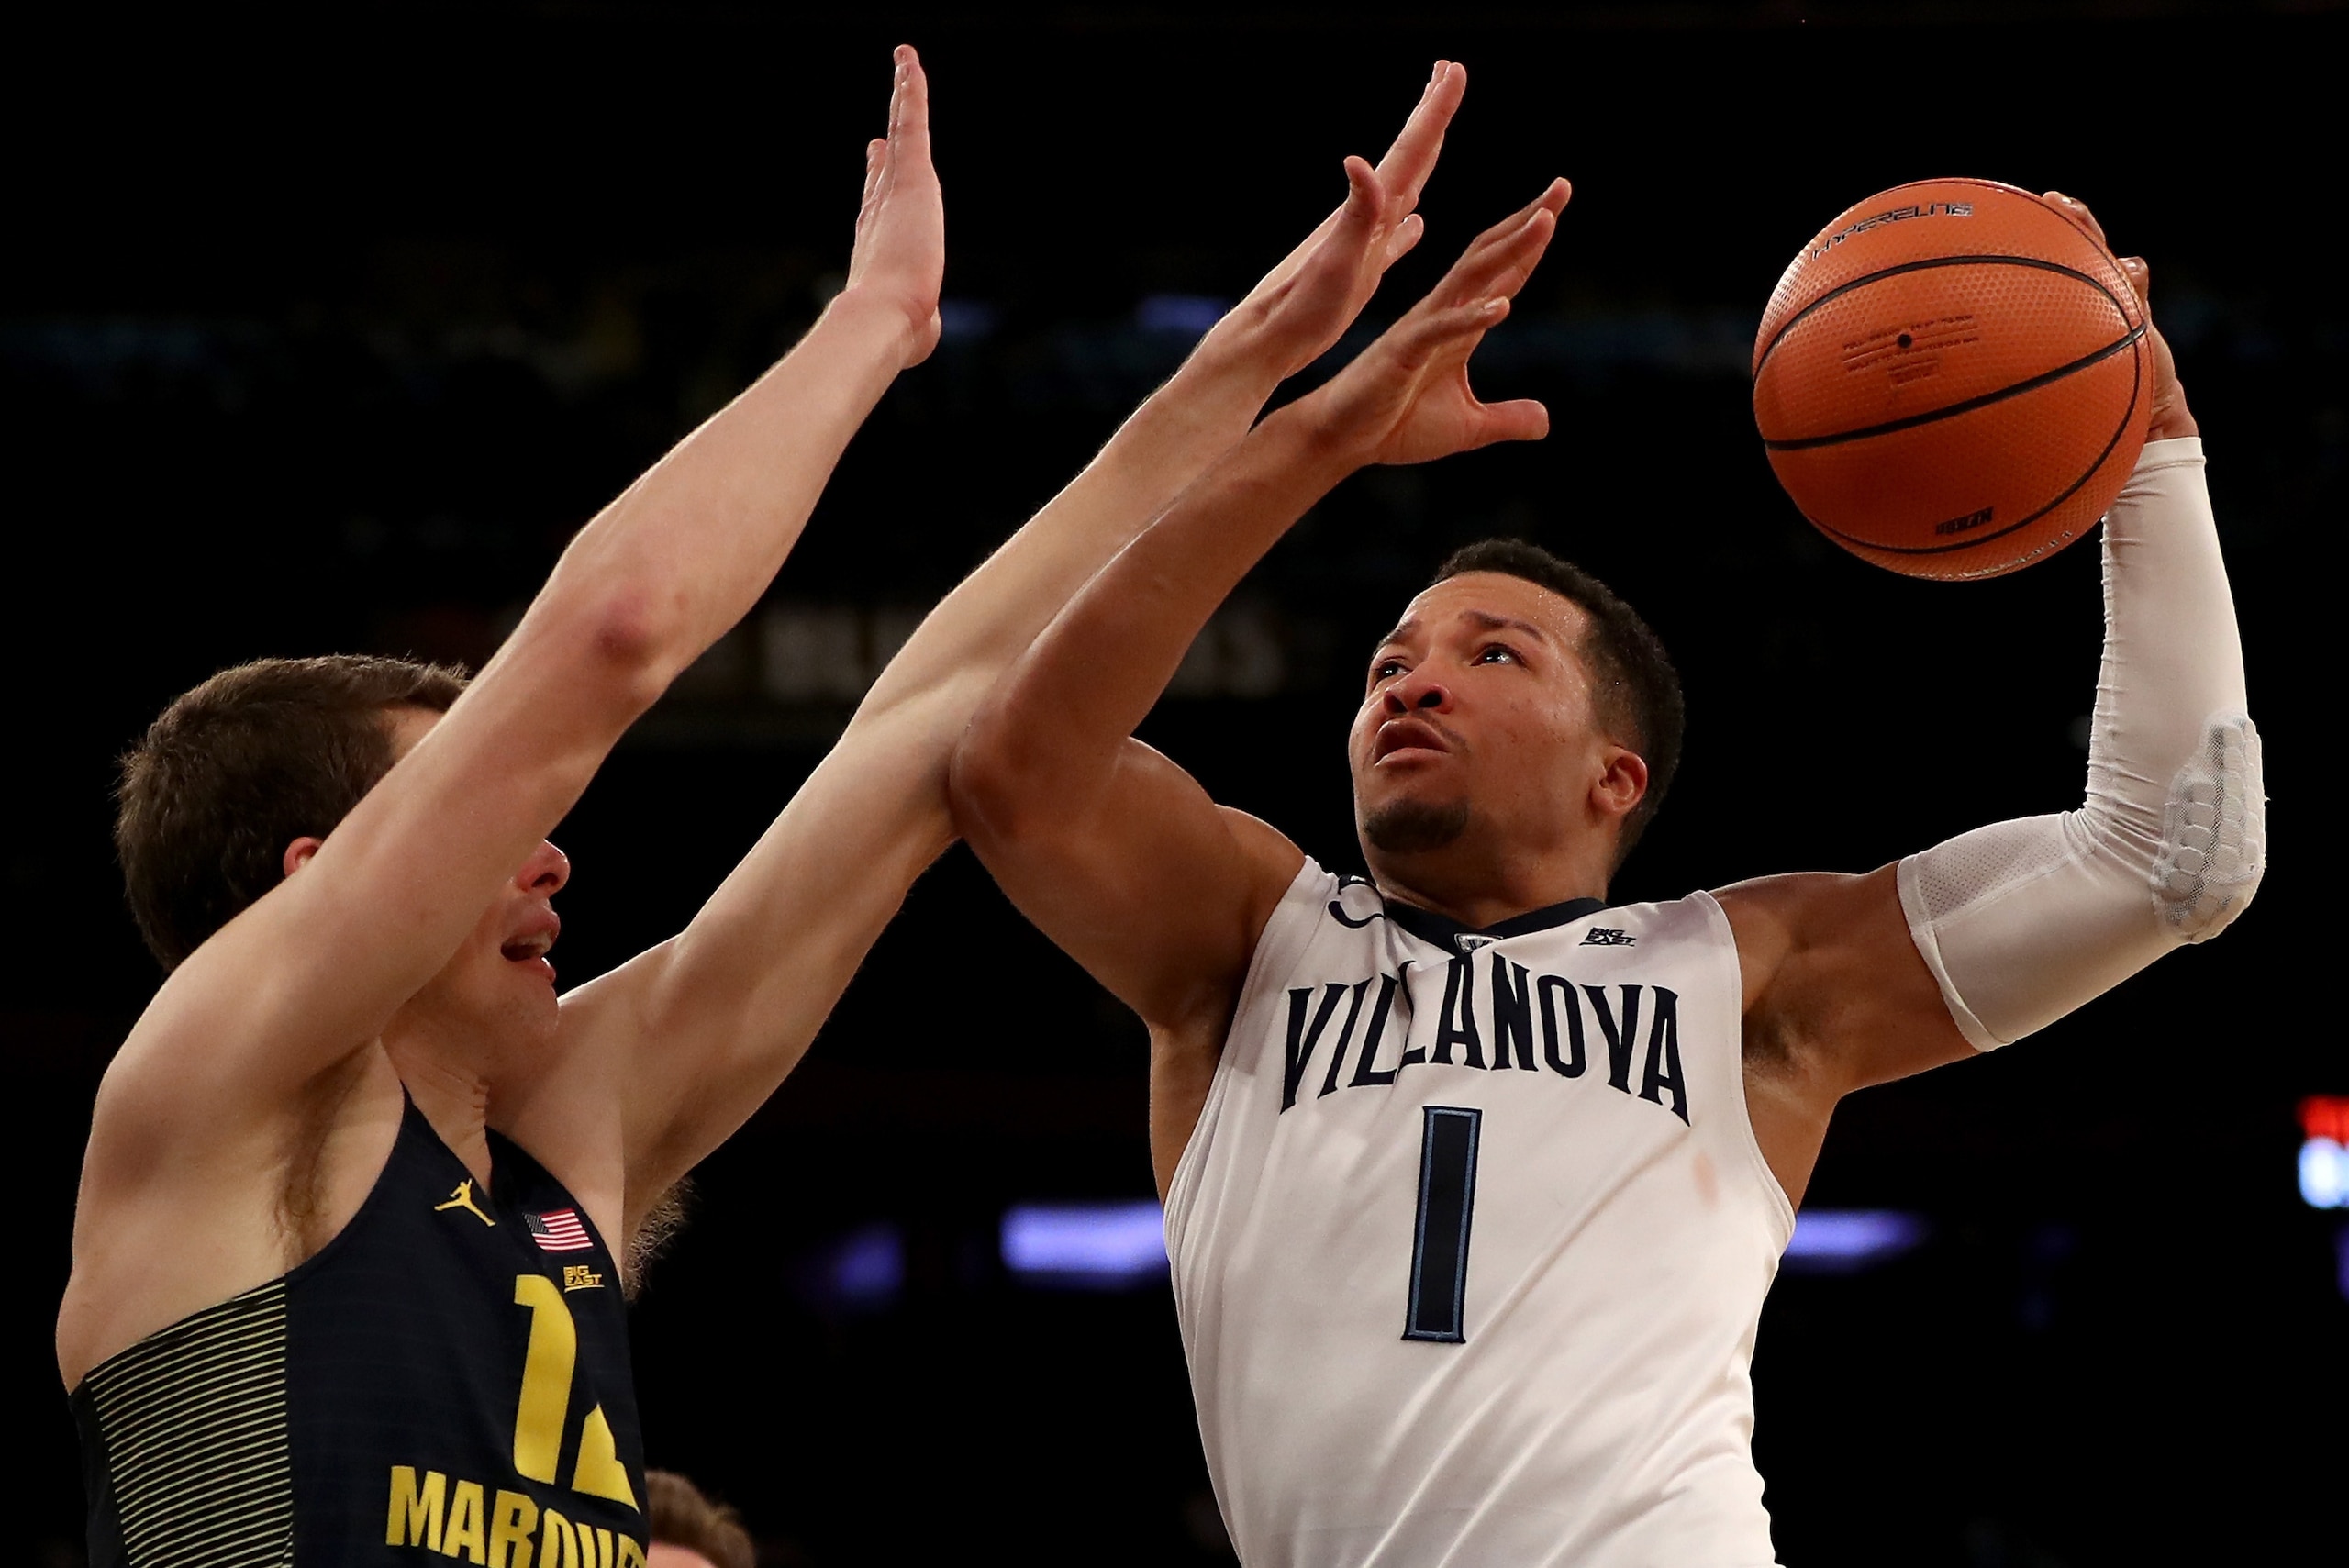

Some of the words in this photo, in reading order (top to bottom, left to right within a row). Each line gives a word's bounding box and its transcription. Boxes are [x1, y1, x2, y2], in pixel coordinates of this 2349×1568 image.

[1591, 928, 1624, 938] BIG
[1585, 935, 1636, 945] EAST
[1280, 951, 1691, 1128] VILLANOVA
[1400, 1106, 1483, 1344] 1
[563, 1265, 589, 1276] BIG
[564, 1273, 603, 1286] EAST
